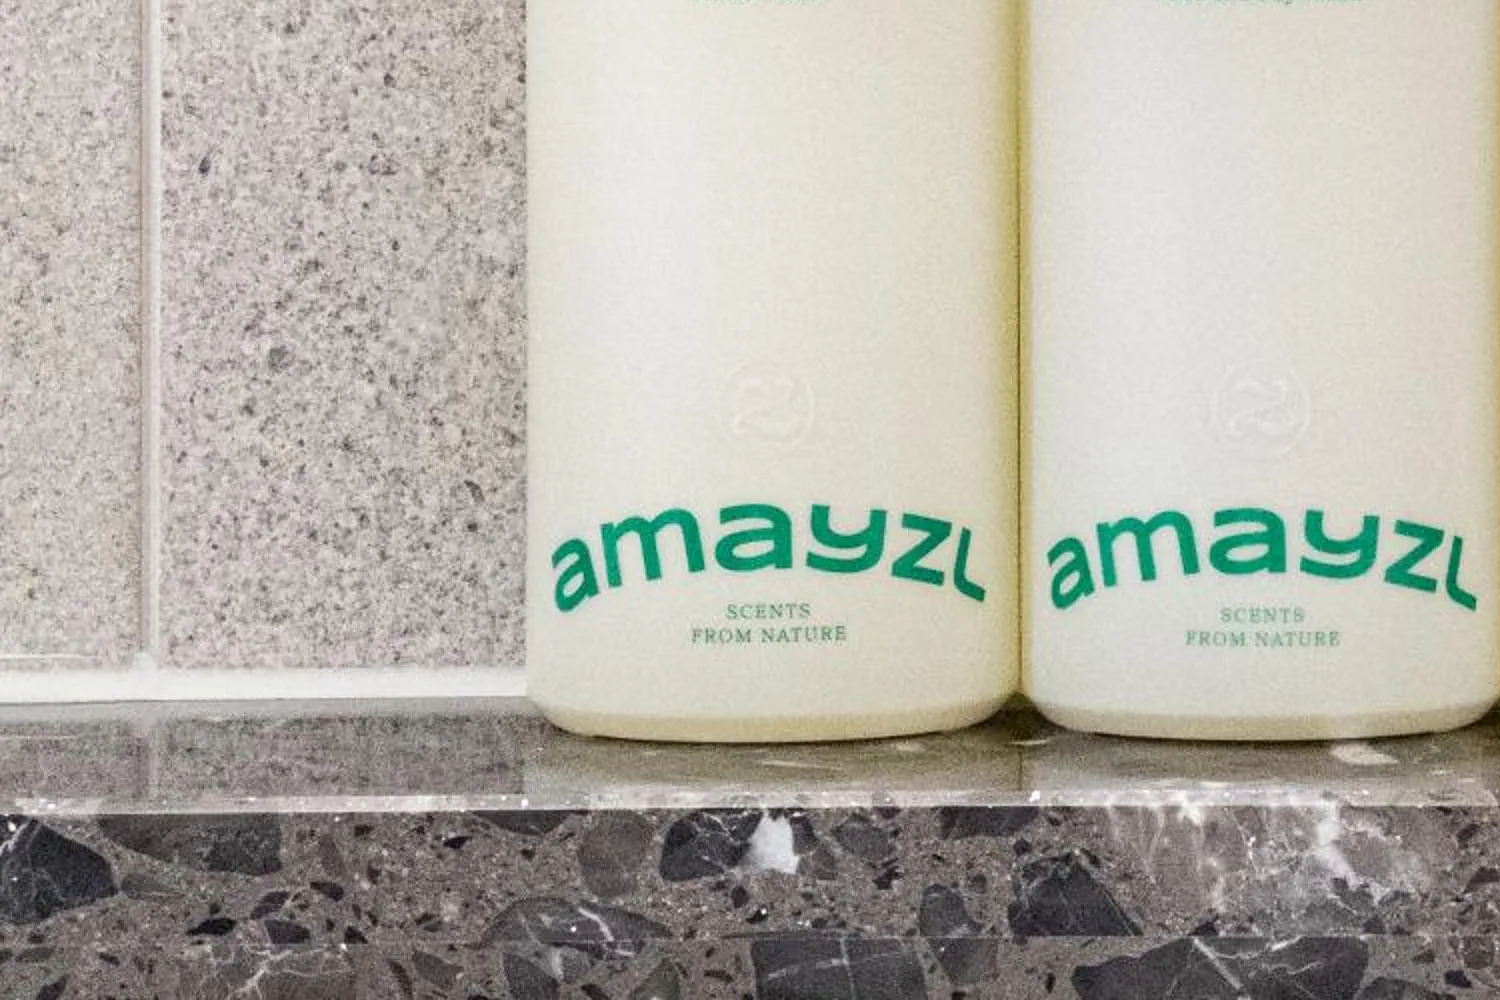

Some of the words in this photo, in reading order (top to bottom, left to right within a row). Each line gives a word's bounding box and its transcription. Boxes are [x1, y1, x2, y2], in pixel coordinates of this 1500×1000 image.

[725, 603, 811, 620] SCENTS
[1219, 607, 1305, 624] SCENTS
[691, 628, 755, 644] FROM
[760, 626, 847, 644] NATURE
[1185, 630, 1250, 647] FROM
[1254, 630, 1341, 648] NATURE
